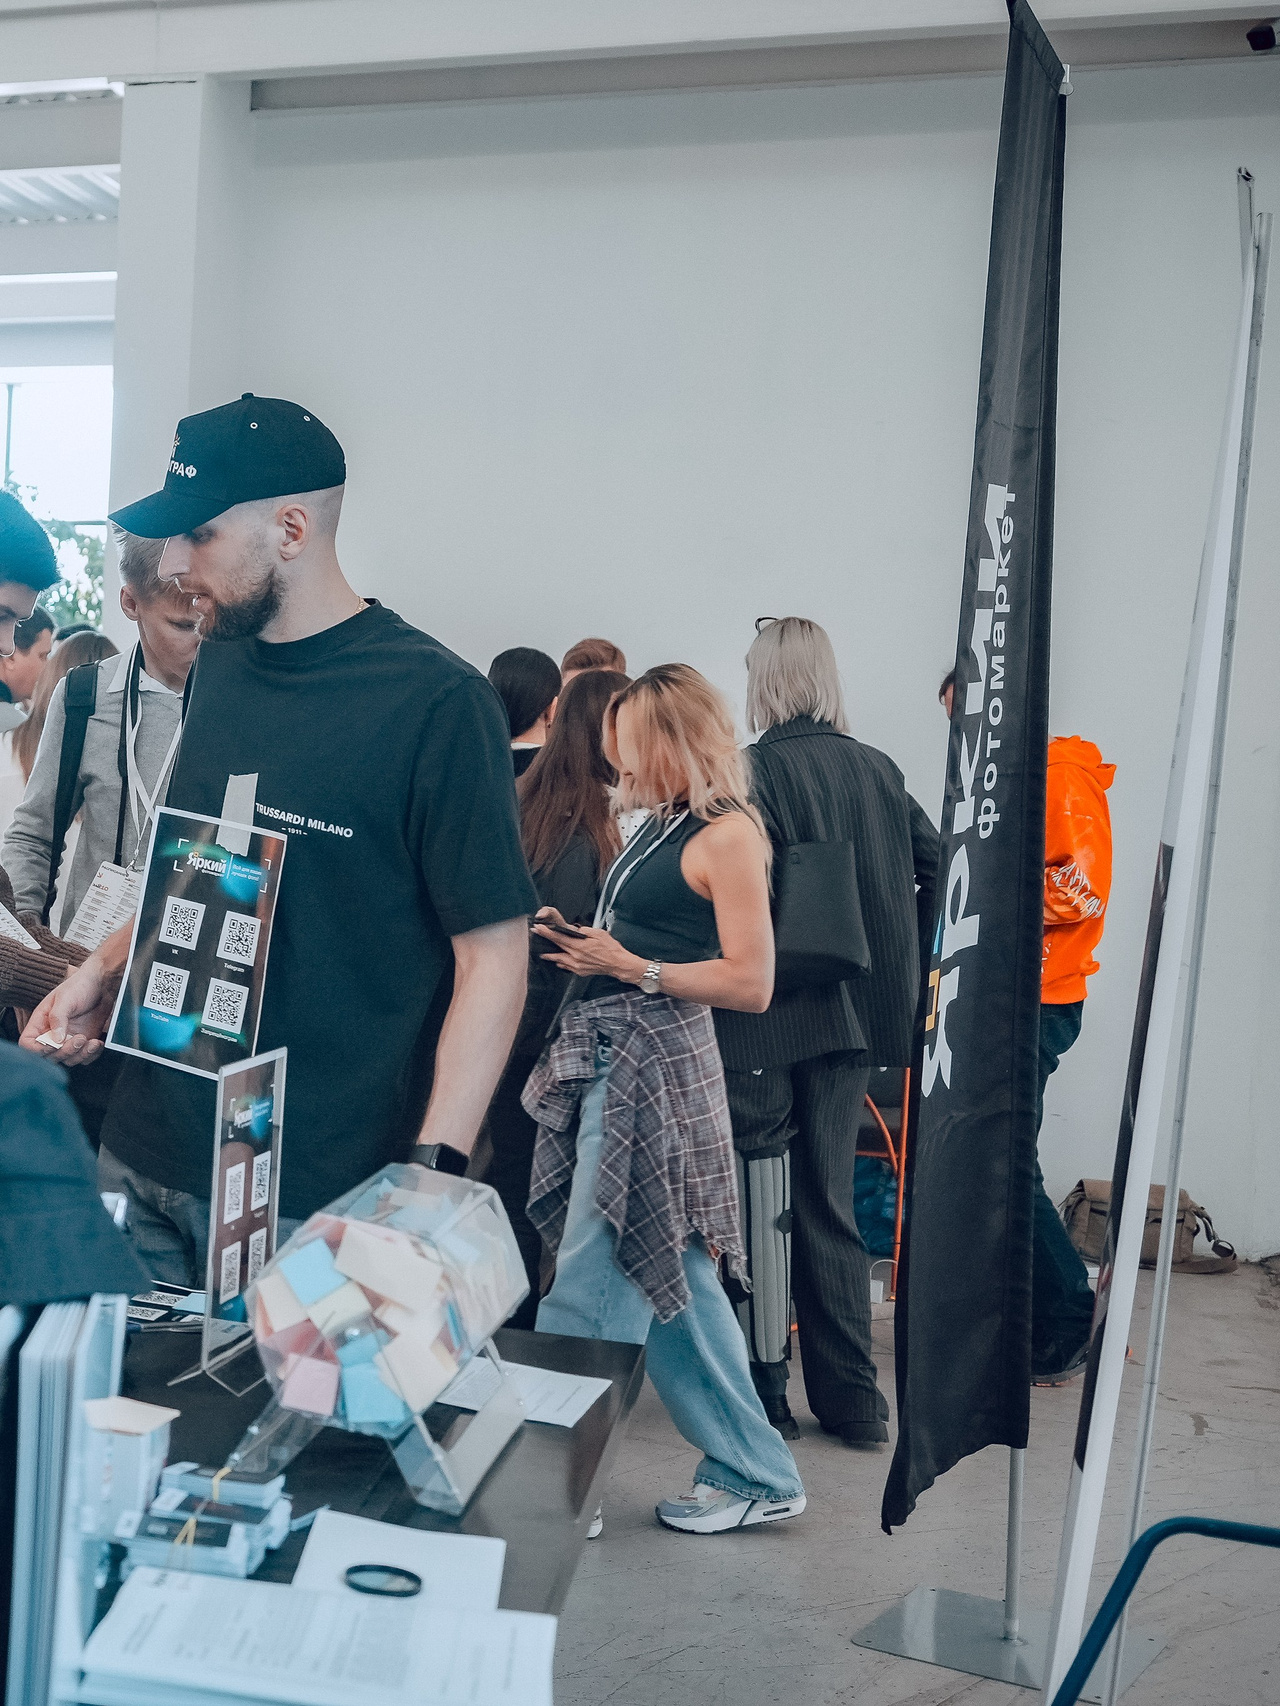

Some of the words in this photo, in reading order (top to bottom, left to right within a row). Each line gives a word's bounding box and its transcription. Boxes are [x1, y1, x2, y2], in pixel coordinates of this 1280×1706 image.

[978, 483, 1016, 839] фотомаркет
[256, 802, 305, 826] TRUSSARDI
[307, 818, 354, 838] MILANO
[287, 827, 302, 836] 1911
[186, 851, 227, 874] Яркий
[224, 962, 245, 973] Telegram
